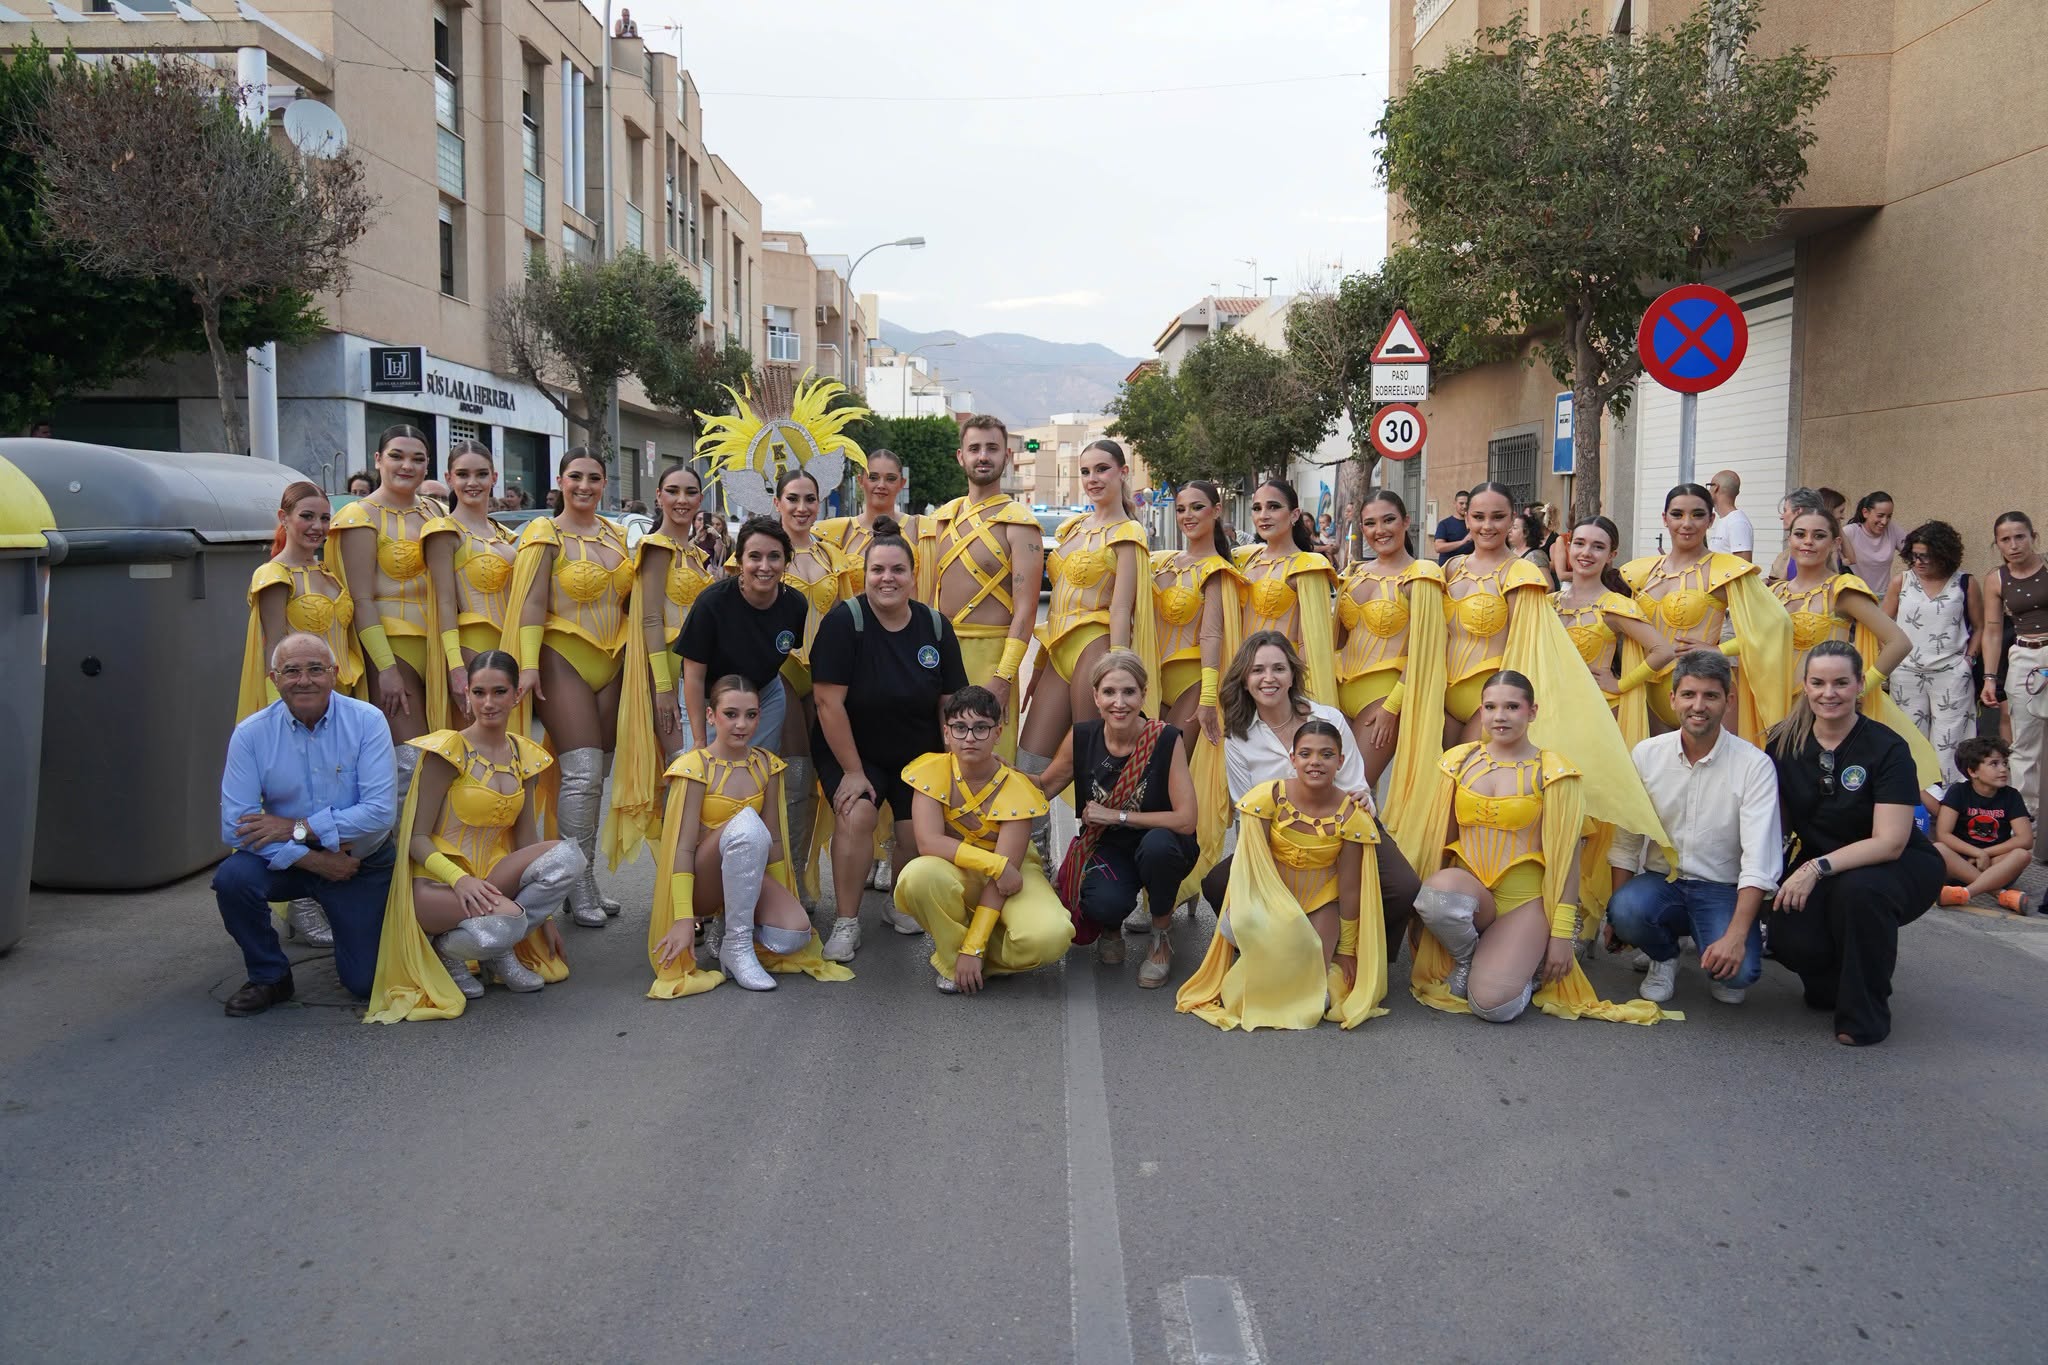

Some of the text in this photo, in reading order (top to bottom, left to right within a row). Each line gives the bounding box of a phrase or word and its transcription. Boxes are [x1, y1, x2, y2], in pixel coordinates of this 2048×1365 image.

[1392, 370, 1409, 381] PASO
[445, 377, 473, 403] LARA
[474, 385, 515, 411] HERRERA
[1375, 386, 1425, 396] SOBREELEVADO
[1386, 420, 1412, 443] 30
